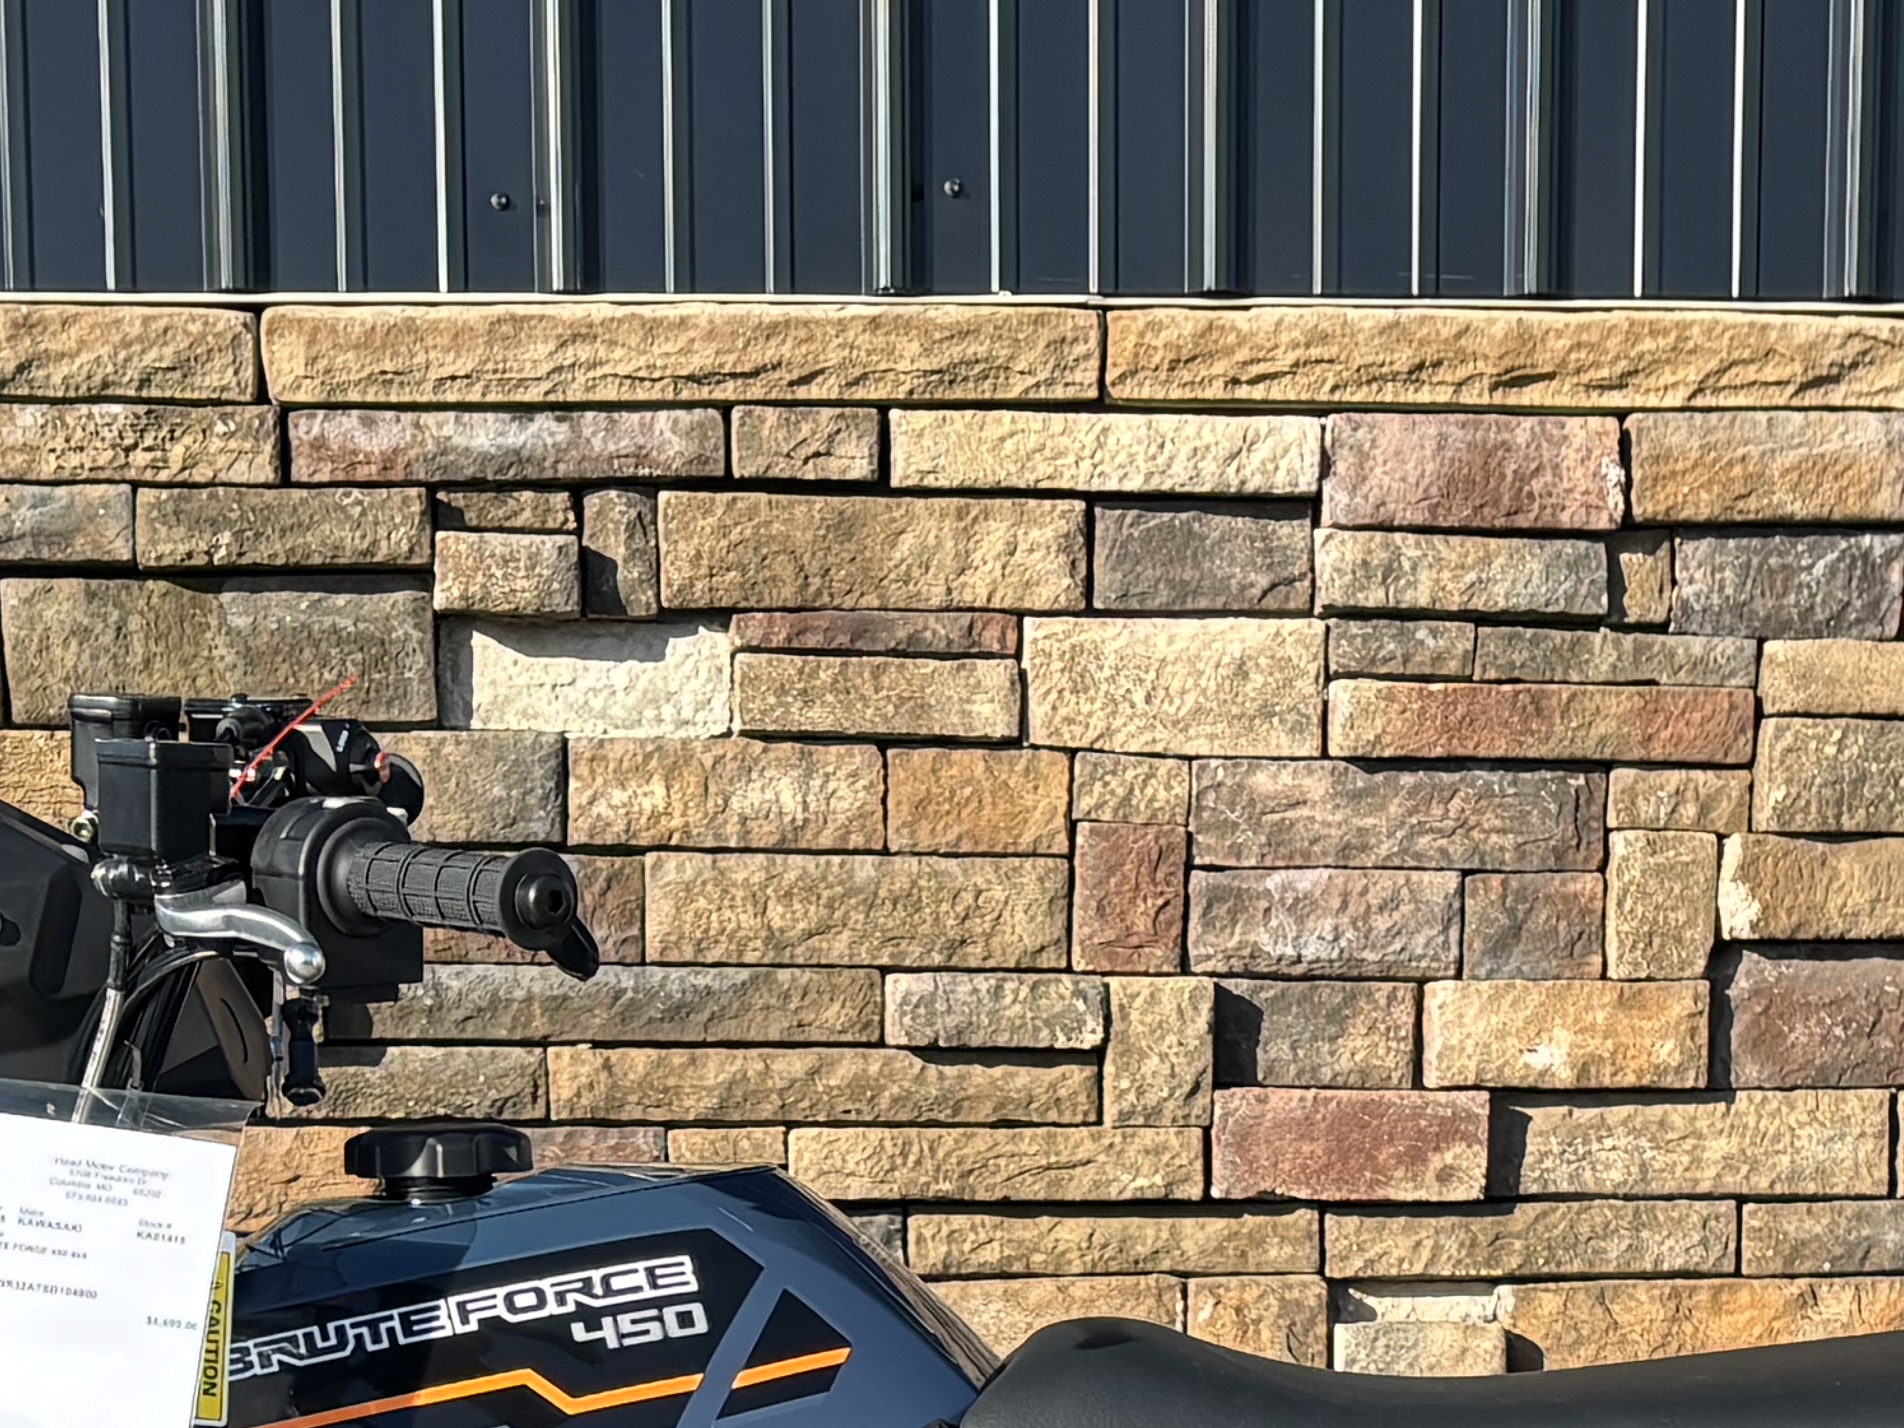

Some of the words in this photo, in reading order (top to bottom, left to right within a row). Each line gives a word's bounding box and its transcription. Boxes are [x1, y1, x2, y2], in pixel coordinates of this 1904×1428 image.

[16, 1215, 83, 1234] KAWASAKI
[202, 1300, 222, 1397] CAUTION
[228, 1299, 454, 1382] BRUTE
[456, 1255, 698, 1333] FORCE
[572, 1302, 709, 1350] 450
